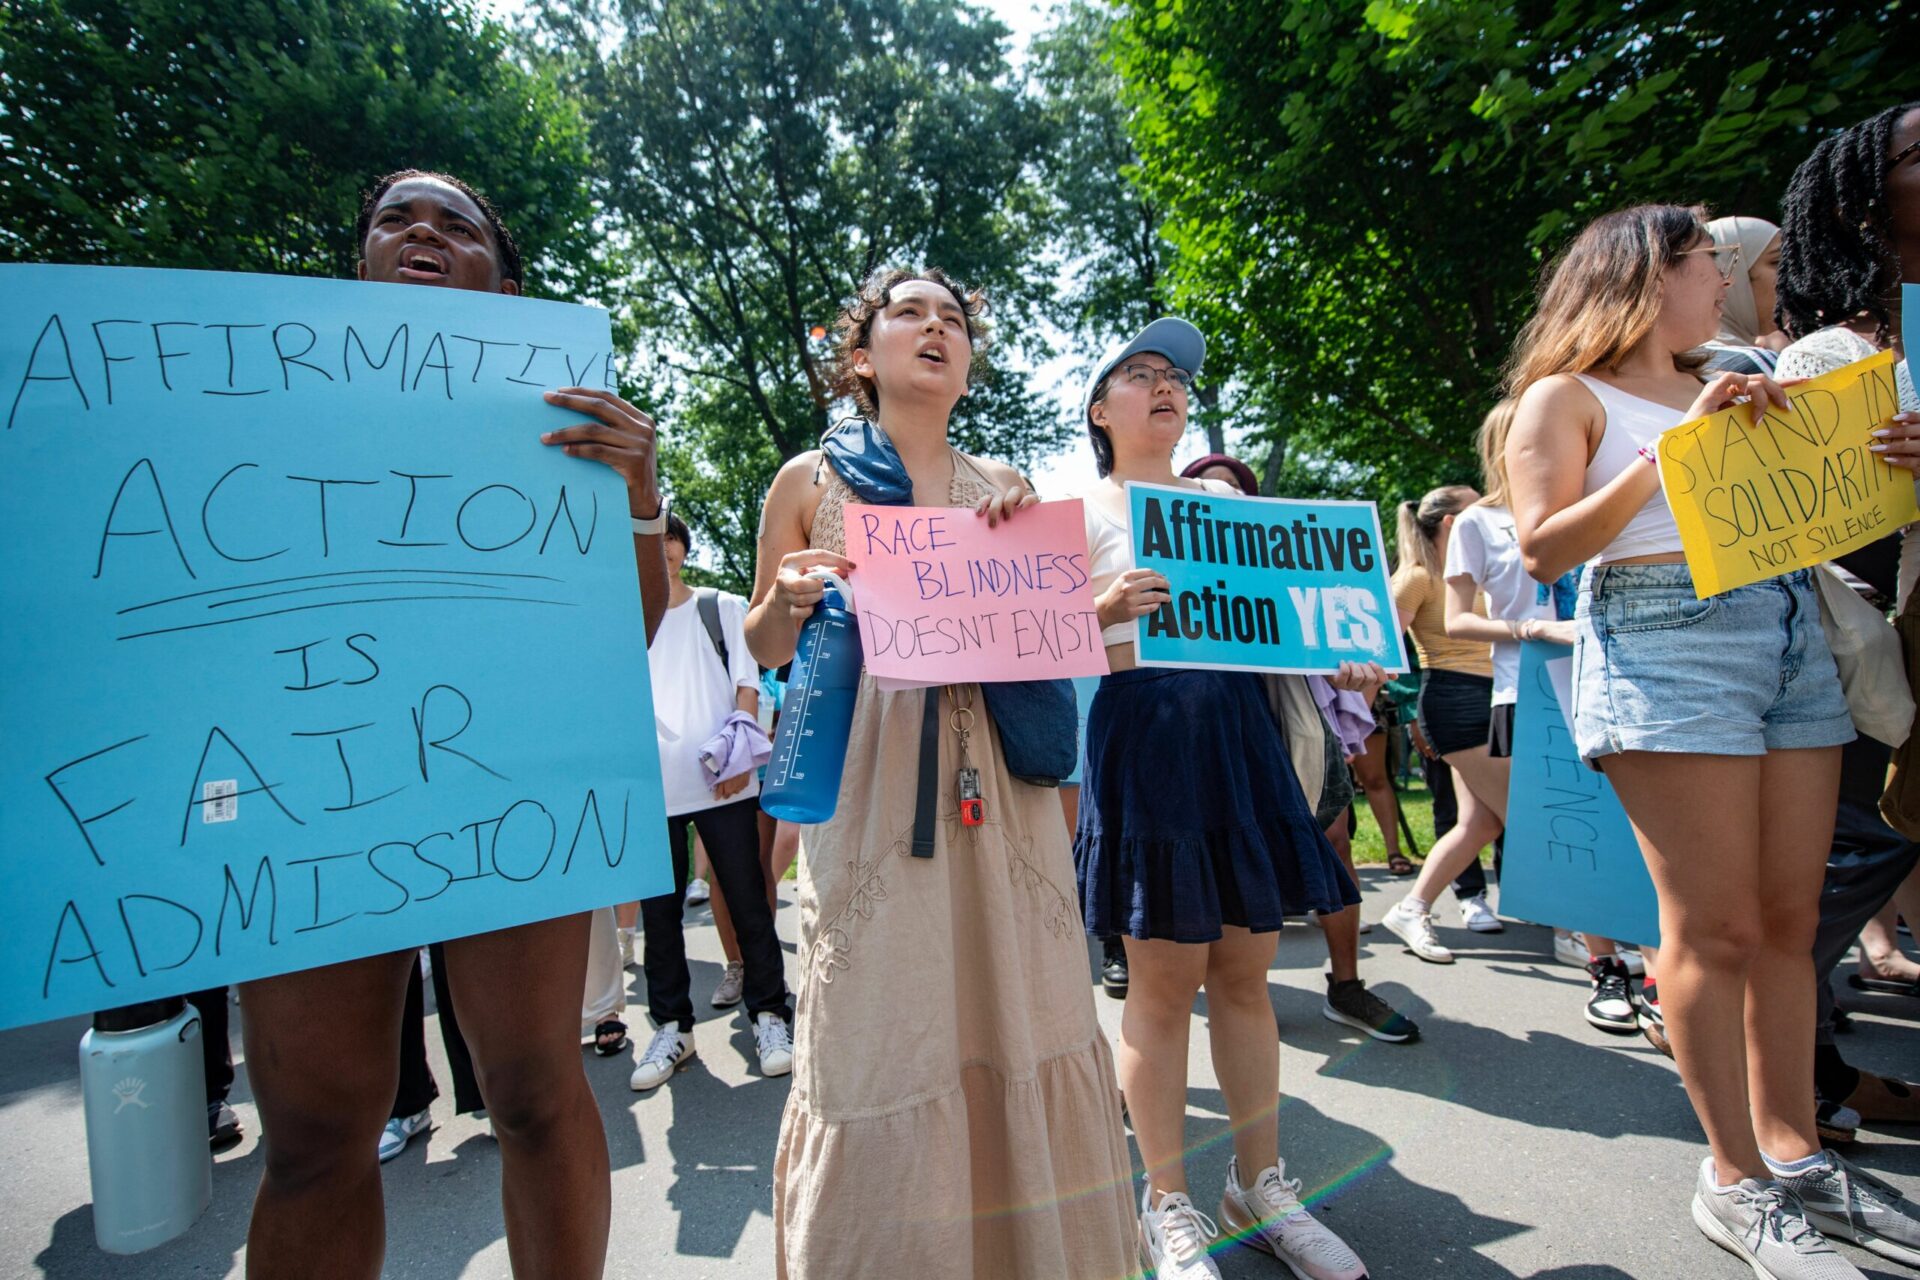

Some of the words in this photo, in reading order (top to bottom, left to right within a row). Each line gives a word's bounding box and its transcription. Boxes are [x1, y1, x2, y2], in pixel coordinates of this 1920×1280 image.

[8, 313, 618, 429] AFFIRMATIVE
[1665, 389, 1840, 494] STAND
[1857, 362, 1900, 431] IN
[93, 458, 598, 580] ACTION
[860, 513, 956, 556] RACE
[1142, 497, 1374, 573] Affirmative
[1748, 533, 1799, 572] NOT
[1806, 504, 1886, 554] SILENCE
[911, 553, 1088, 600] BLINDNESS
[863, 610, 1000, 660] DOESN'T
[1010, 609, 1096, 663] EXIST
[1147, 580, 1280, 646] Action
[1287, 583, 1391, 658] YES
[274, 633, 379, 691] IS
[45, 684, 512, 866] FAIR
[43, 788, 630, 999] ADMISSION
